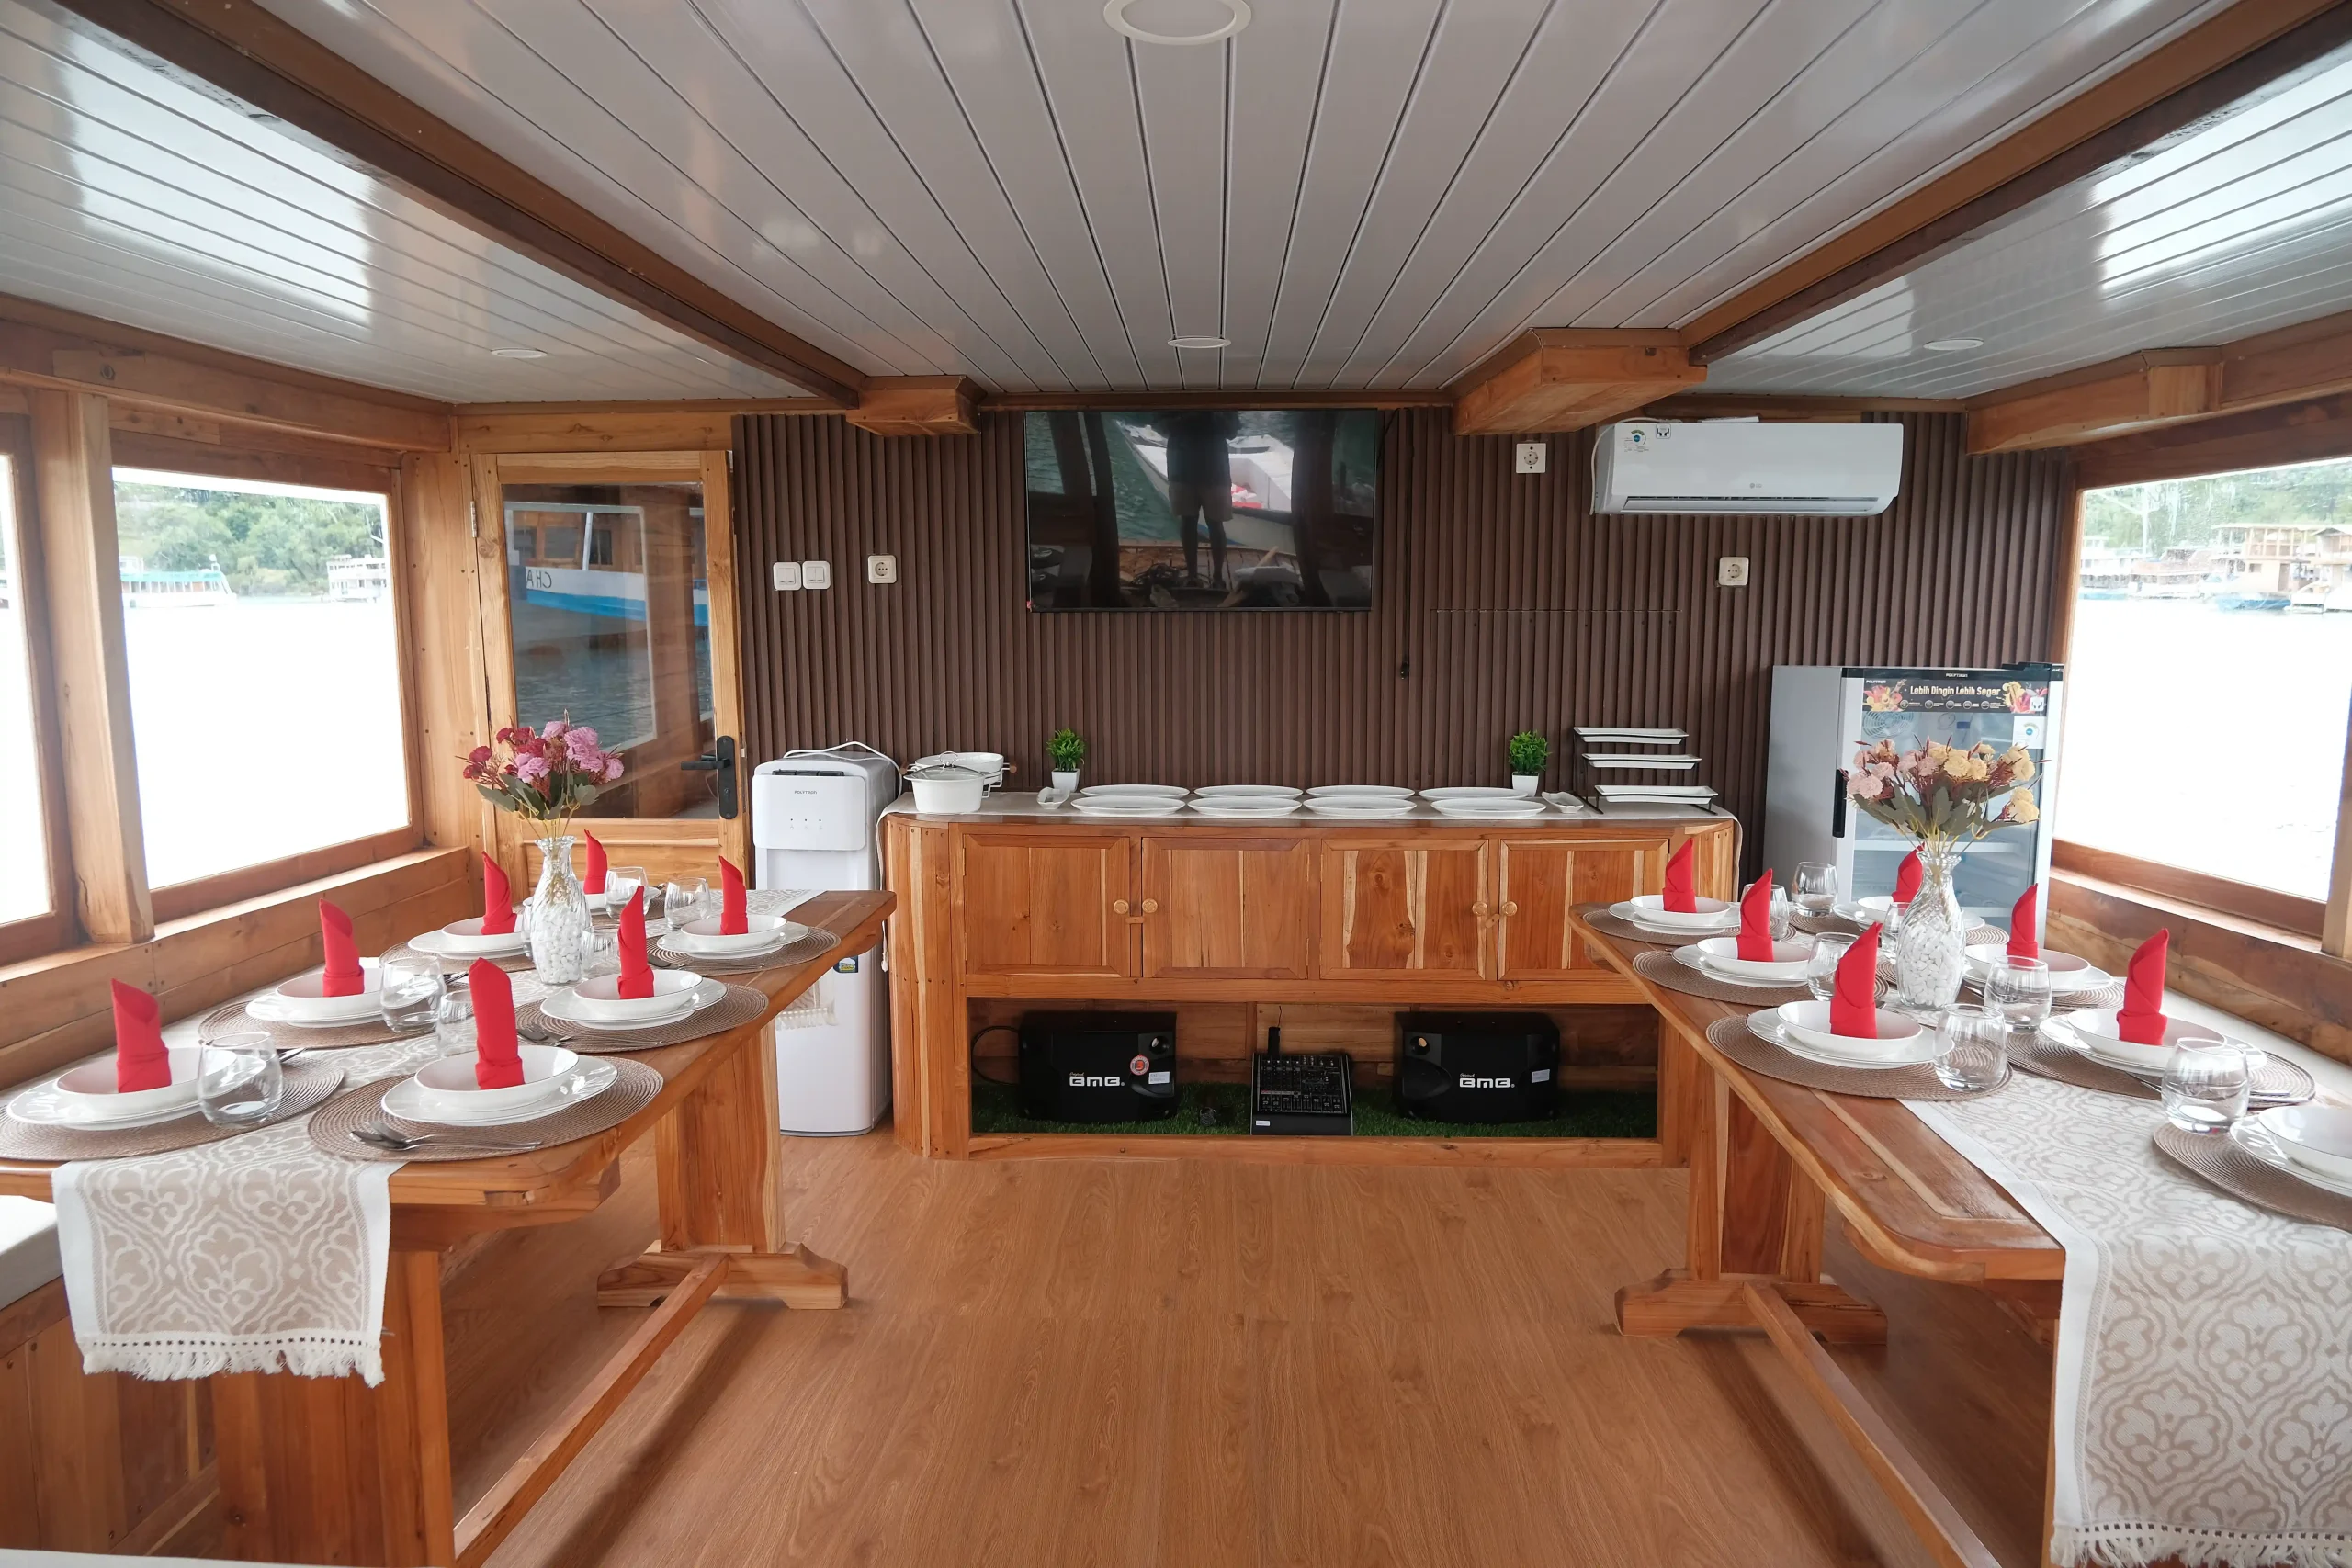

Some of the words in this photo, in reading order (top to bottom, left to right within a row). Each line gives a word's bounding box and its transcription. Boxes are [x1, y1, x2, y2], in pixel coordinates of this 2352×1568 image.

[1910, 685, 1929, 694] Lebih
[1931, 686, 1954, 697] Dingin
[1956, 686, 1975, 695] Lebih
[1976, 687, 2001, 697] Segar
